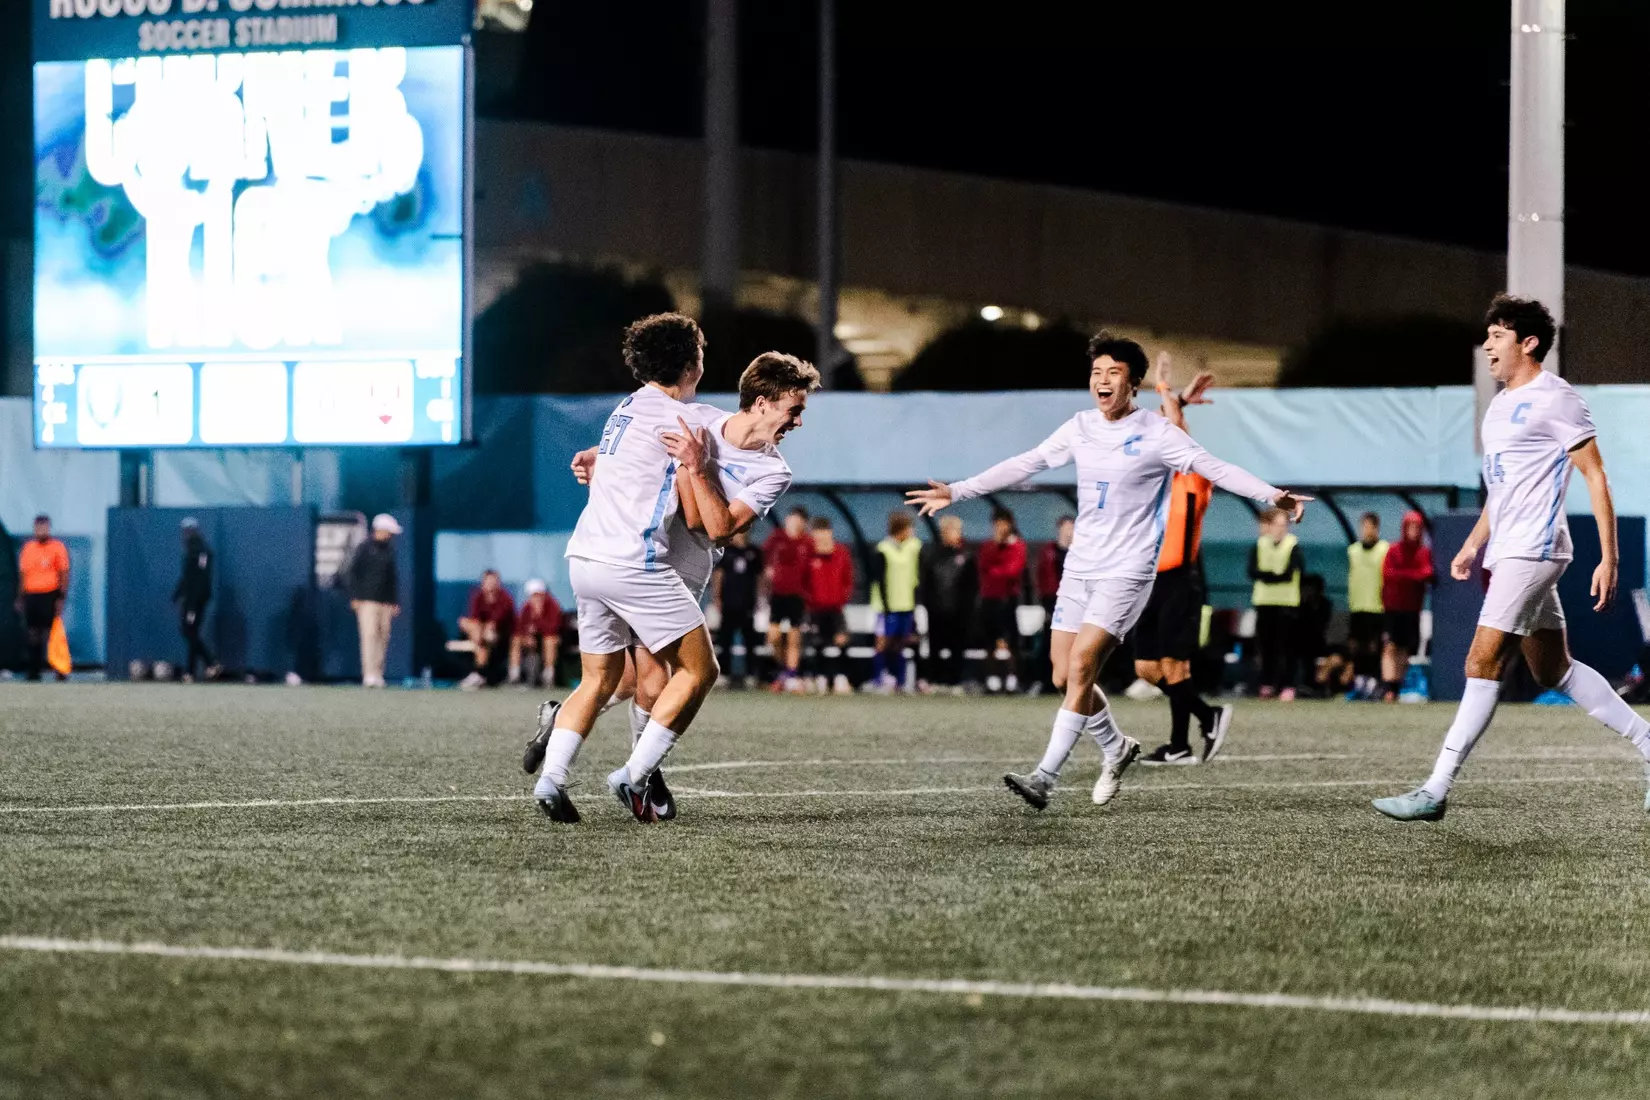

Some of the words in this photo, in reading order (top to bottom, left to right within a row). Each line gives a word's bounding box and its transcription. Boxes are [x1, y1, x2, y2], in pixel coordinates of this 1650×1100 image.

[138, 18, 230, 51] SOCCER
[234, 13, 338, 47] STADIUM
[1510, 402, 1532, 425] C
[598, 414, 634, 455] 27
[1123, 434, 1143, 456] C
[1096, 481, 1110, 509] 7
